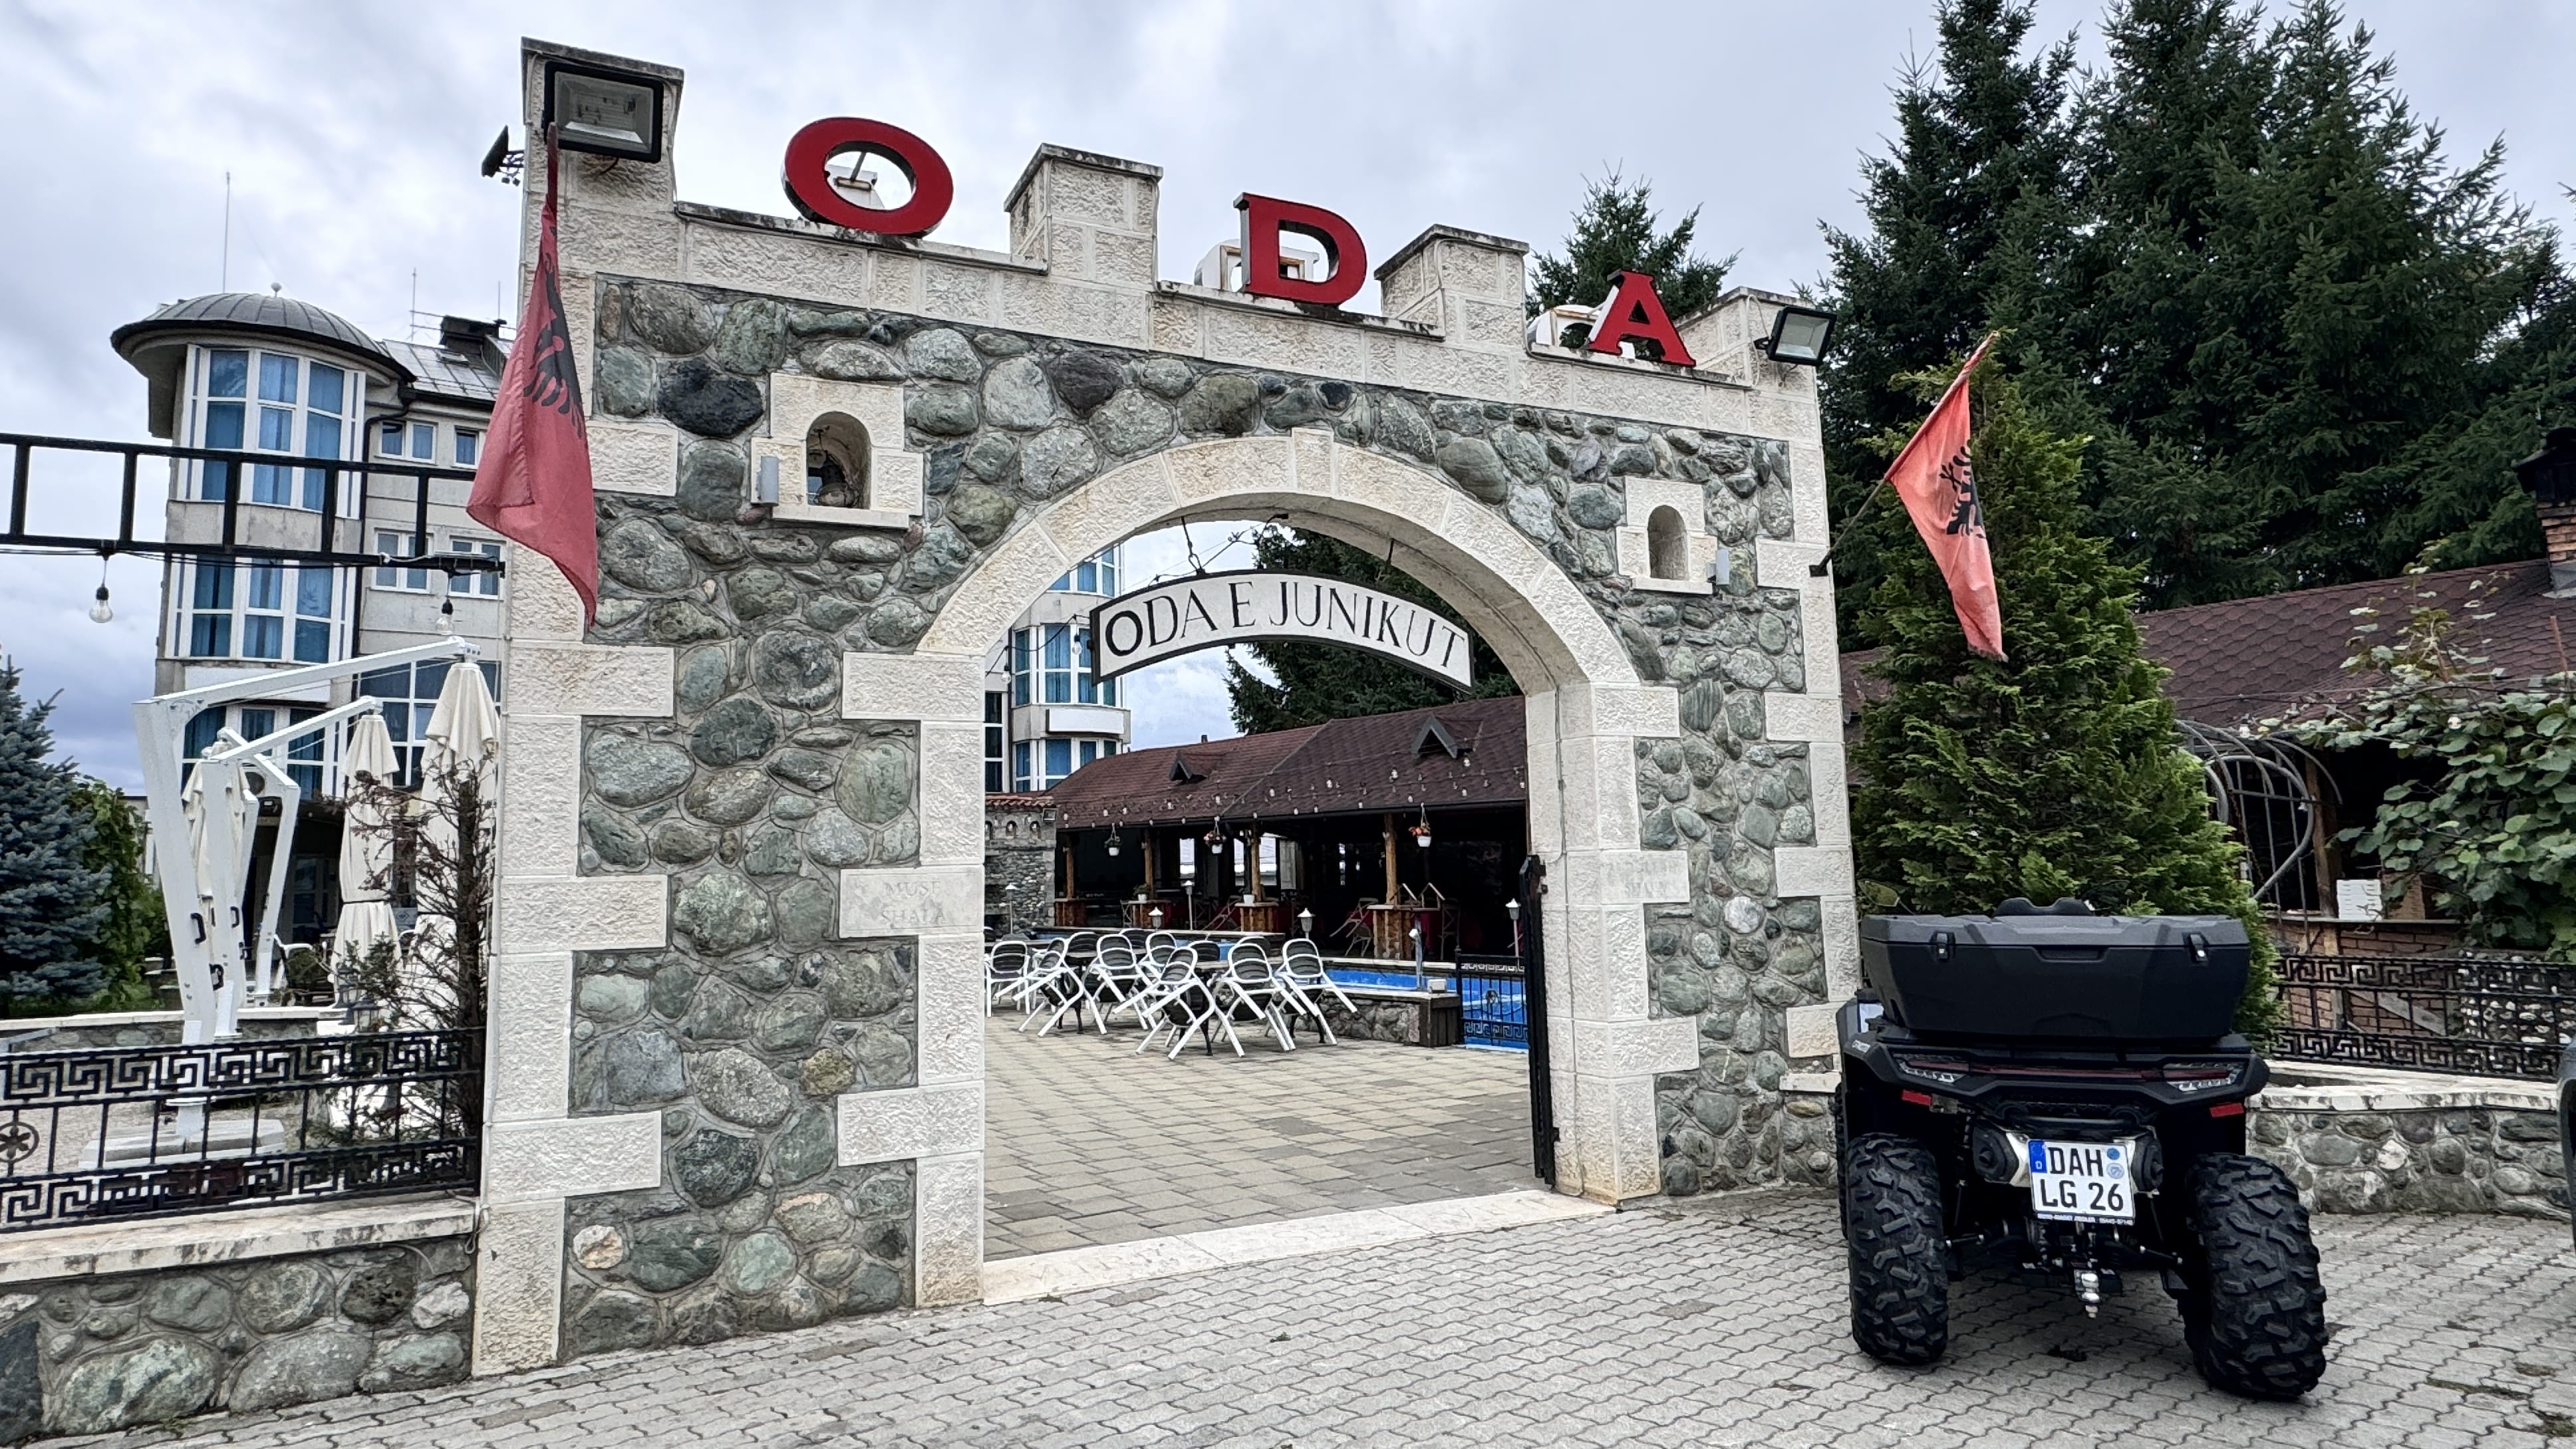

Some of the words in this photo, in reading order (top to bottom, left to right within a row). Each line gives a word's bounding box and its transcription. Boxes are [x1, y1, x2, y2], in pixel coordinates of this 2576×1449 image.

[1105, 589, 1219, 657] ODA
[1228, 582, 1256, 628] E
[1269, 582, 1465, 668] JUNIKUT
[2035, 1160, 2043, 1170] D
[2048, 1147, 2104, 1176] DAH
[2040, 1179, 2077, 1208] LG
[2088, 1182, 2124, 1212] 26
